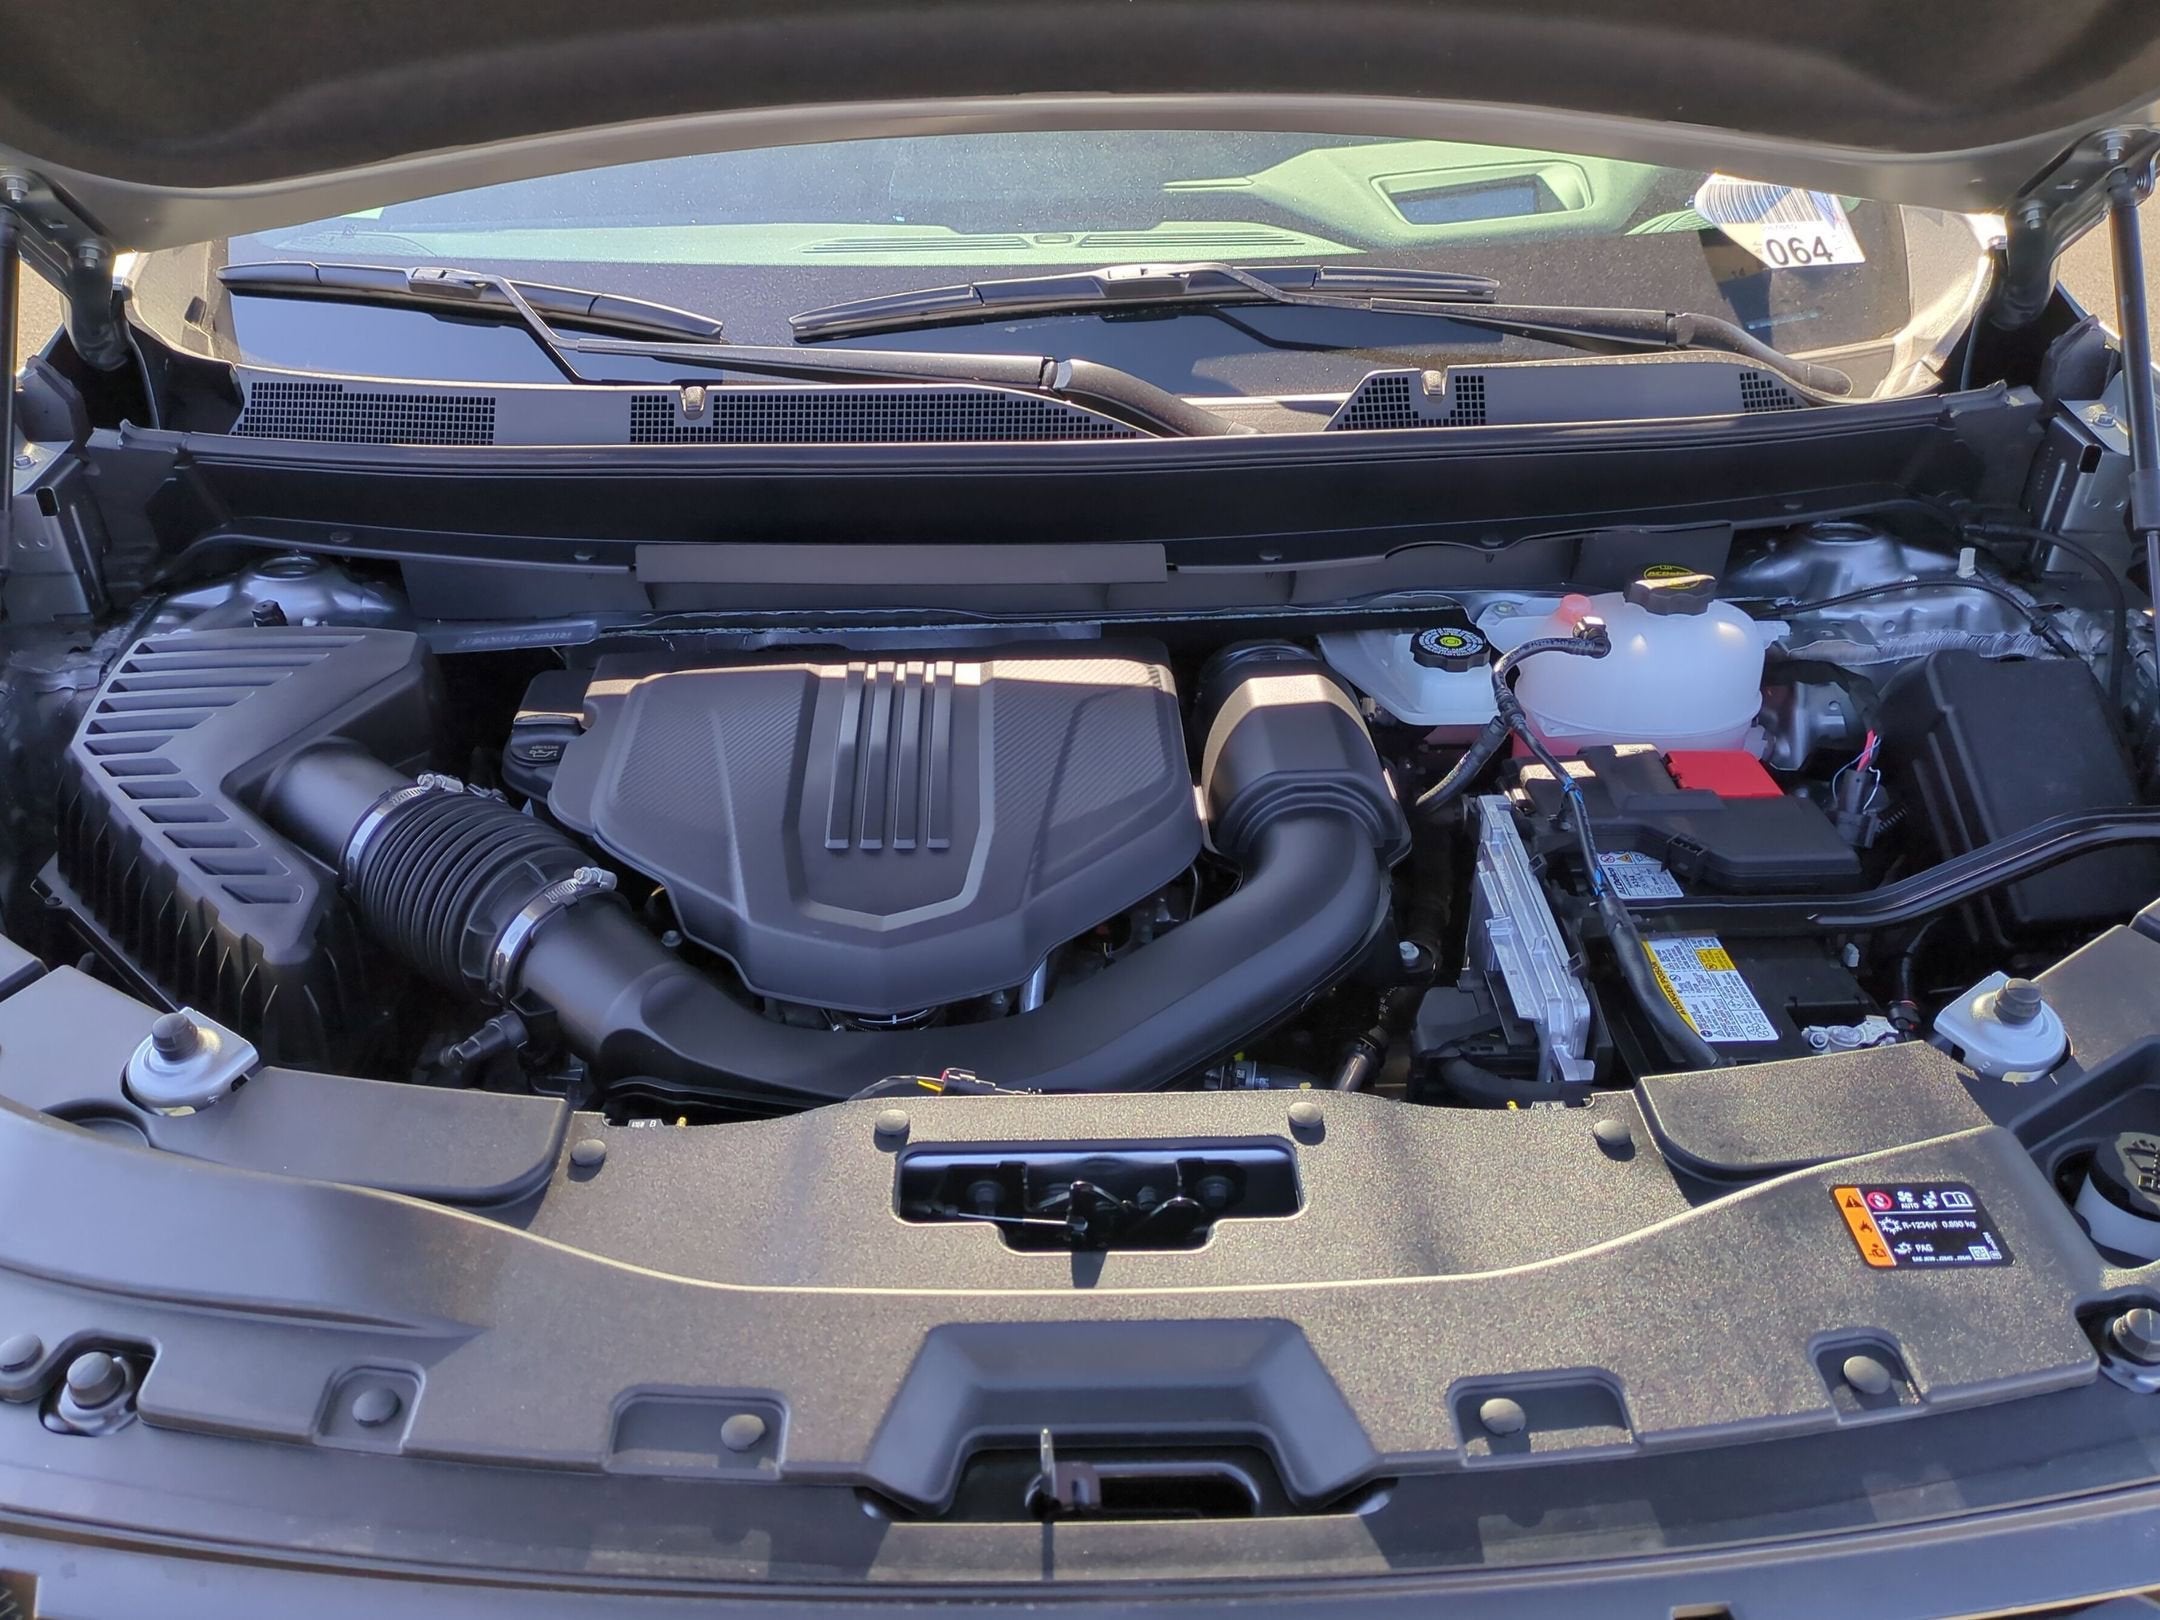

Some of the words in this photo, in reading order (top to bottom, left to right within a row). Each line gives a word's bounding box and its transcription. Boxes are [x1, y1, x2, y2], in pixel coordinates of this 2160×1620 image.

[1765, 236, 1833, 266] 064
[1901, 1221, 1937, 1230] R-1234yf
[1964, 1220, 1977, 1229] kg
[1915, 1244, 1933, 1252] PAG
